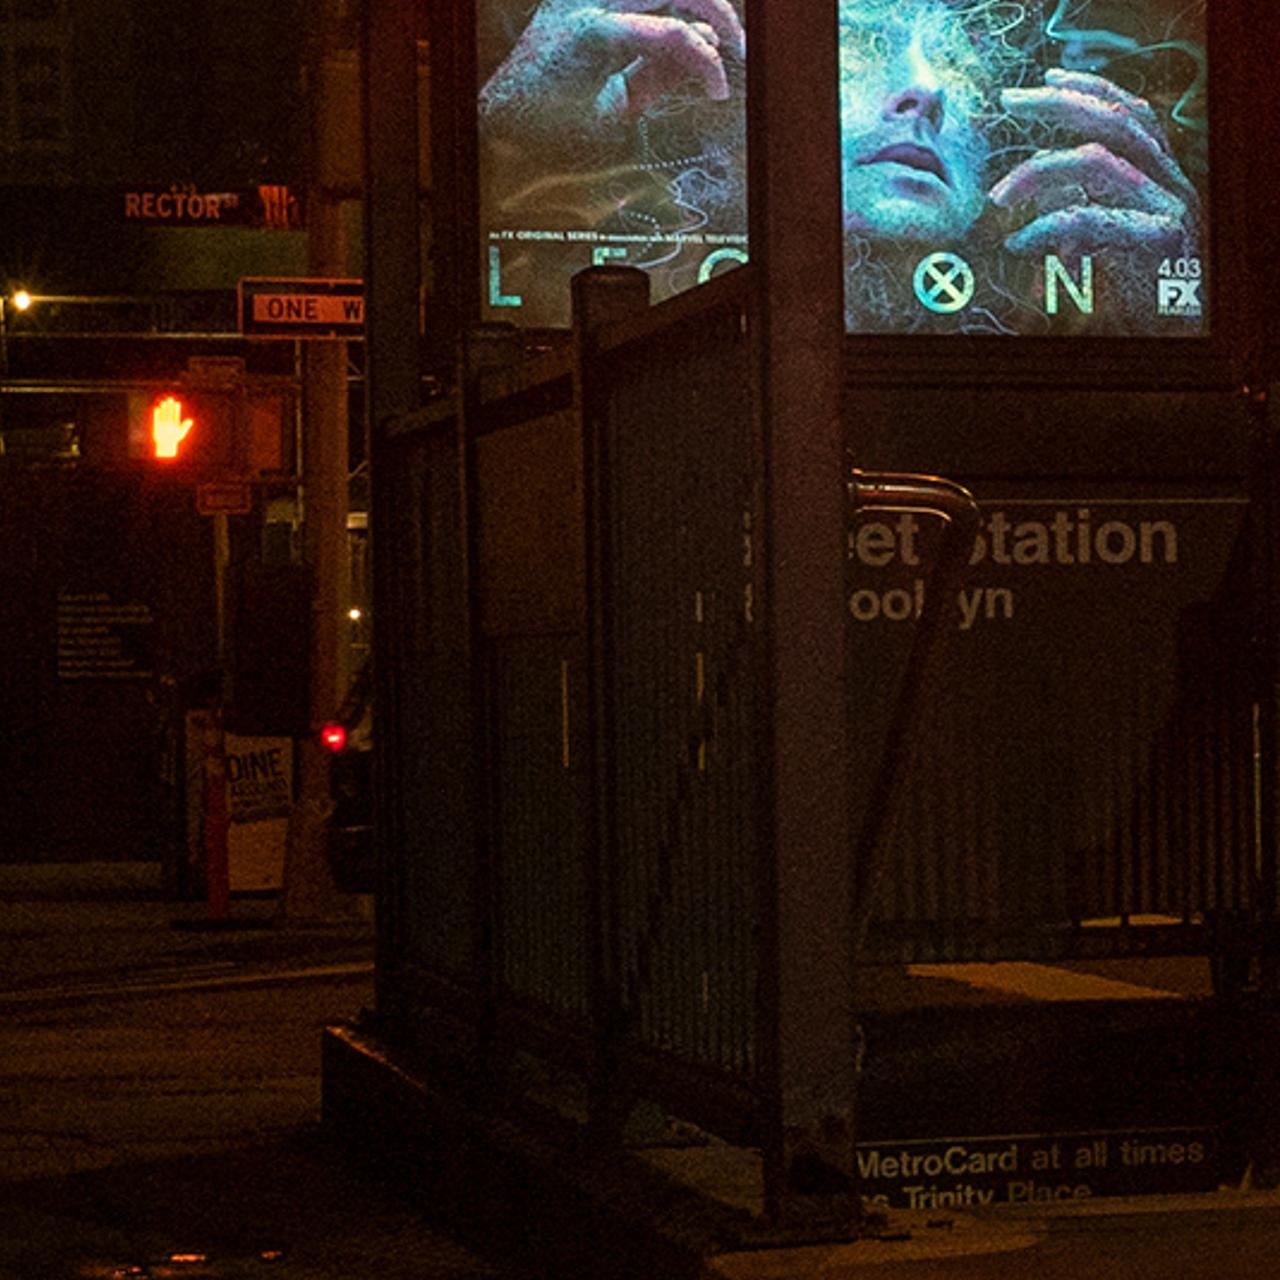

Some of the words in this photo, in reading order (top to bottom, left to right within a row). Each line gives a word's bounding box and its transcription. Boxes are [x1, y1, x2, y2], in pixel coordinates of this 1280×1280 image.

[124, 191, 222, 220] RECTOR
[515, 231, 565, 242] ORIGINAL
[567, 231, 599, 242] SERIES
[1157, 257, 1202, 278] 4.03
[1157, 278, 1202, 307] FX
[267, 297, 319, 320] ONE
[225, 747, 283, 783] DINE
[1030, 1142, 1061, 1171] at
[1073, 1141, 1110, 1169] all
[1119, 1138, 1206, 1166] times
[1007, 1180, 1093, 1204] Place
